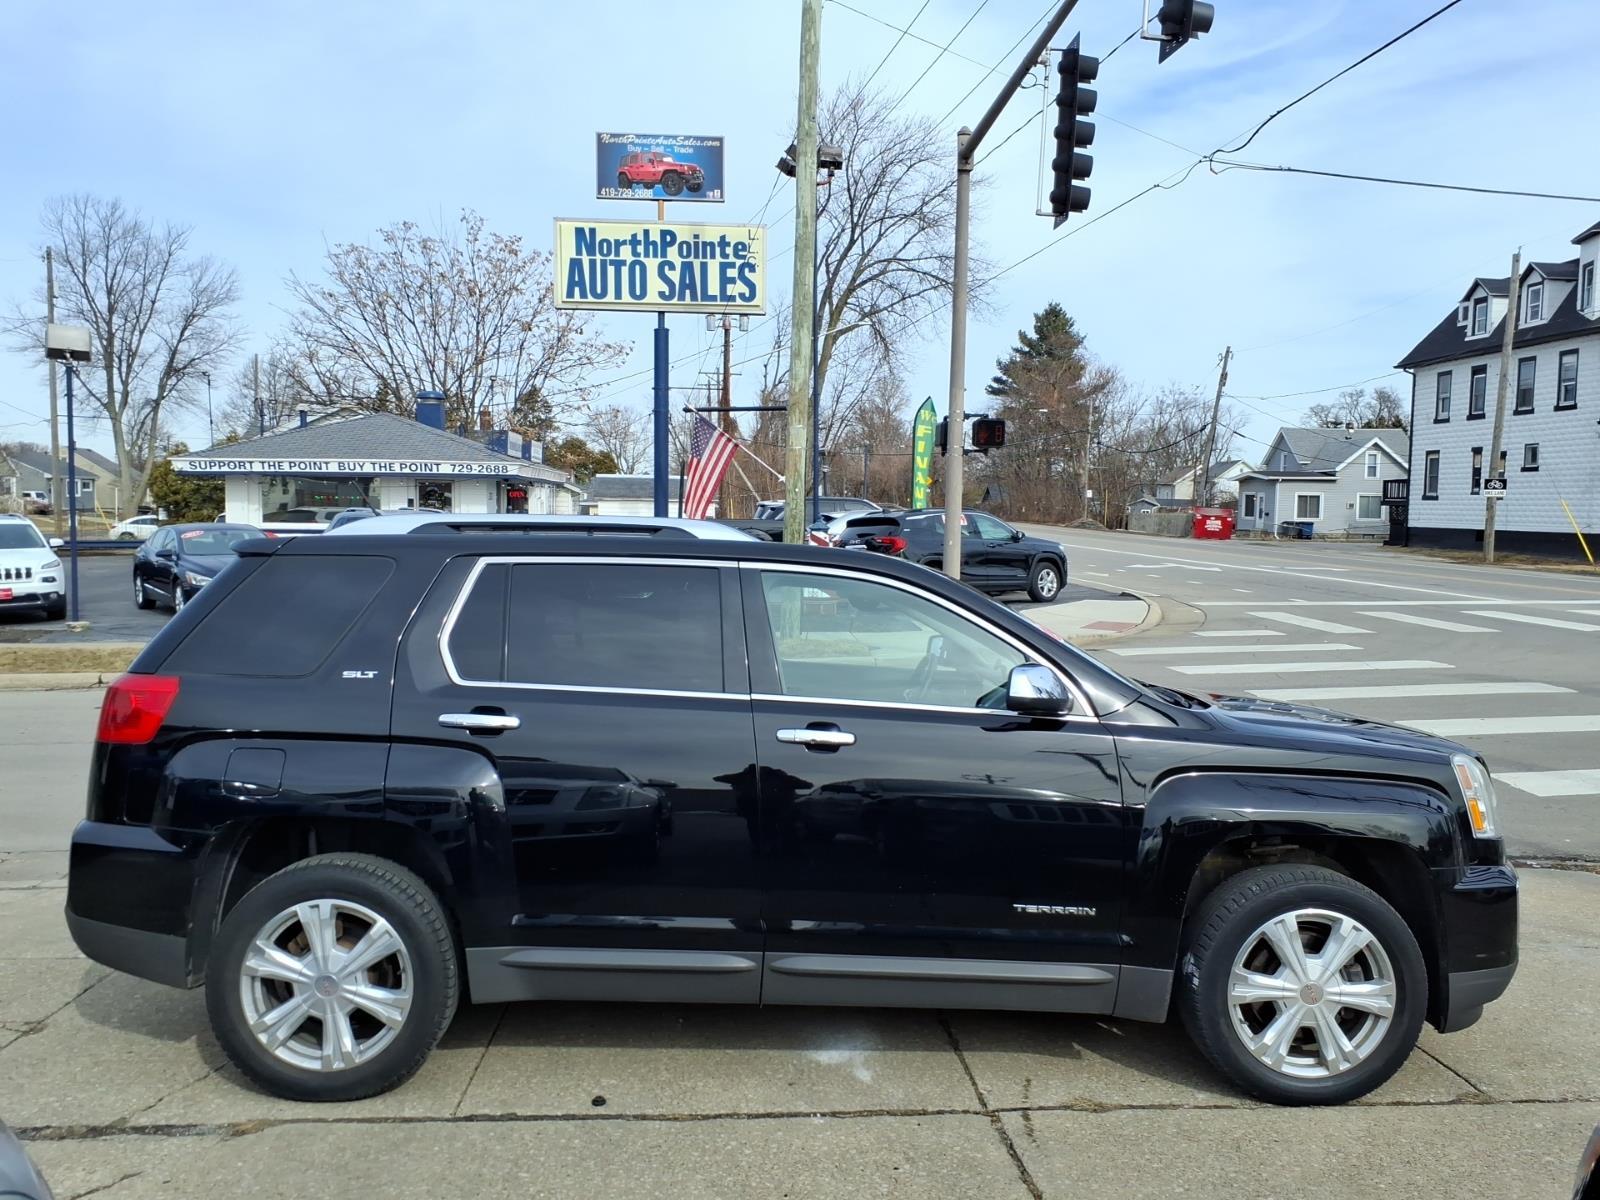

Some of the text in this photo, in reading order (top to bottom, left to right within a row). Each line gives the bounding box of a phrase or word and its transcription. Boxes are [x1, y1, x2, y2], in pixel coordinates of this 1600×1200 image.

[600, 133, 721, 147] NorthPointeAutoSales.com
[627, 144, 642, 153] Buy
[650, 145, 665, 153] Sell
[674, 146, 694, 154] Trade
[574, 226, 748, 260] NorthPointe
[565, 257, 757, 303] AUTO SALES
[188, 460, 509, 474] SUPPORT THE POINT BUY THE POINT 729-2688
[1013, 904, 1096, 916] TERRAIN
